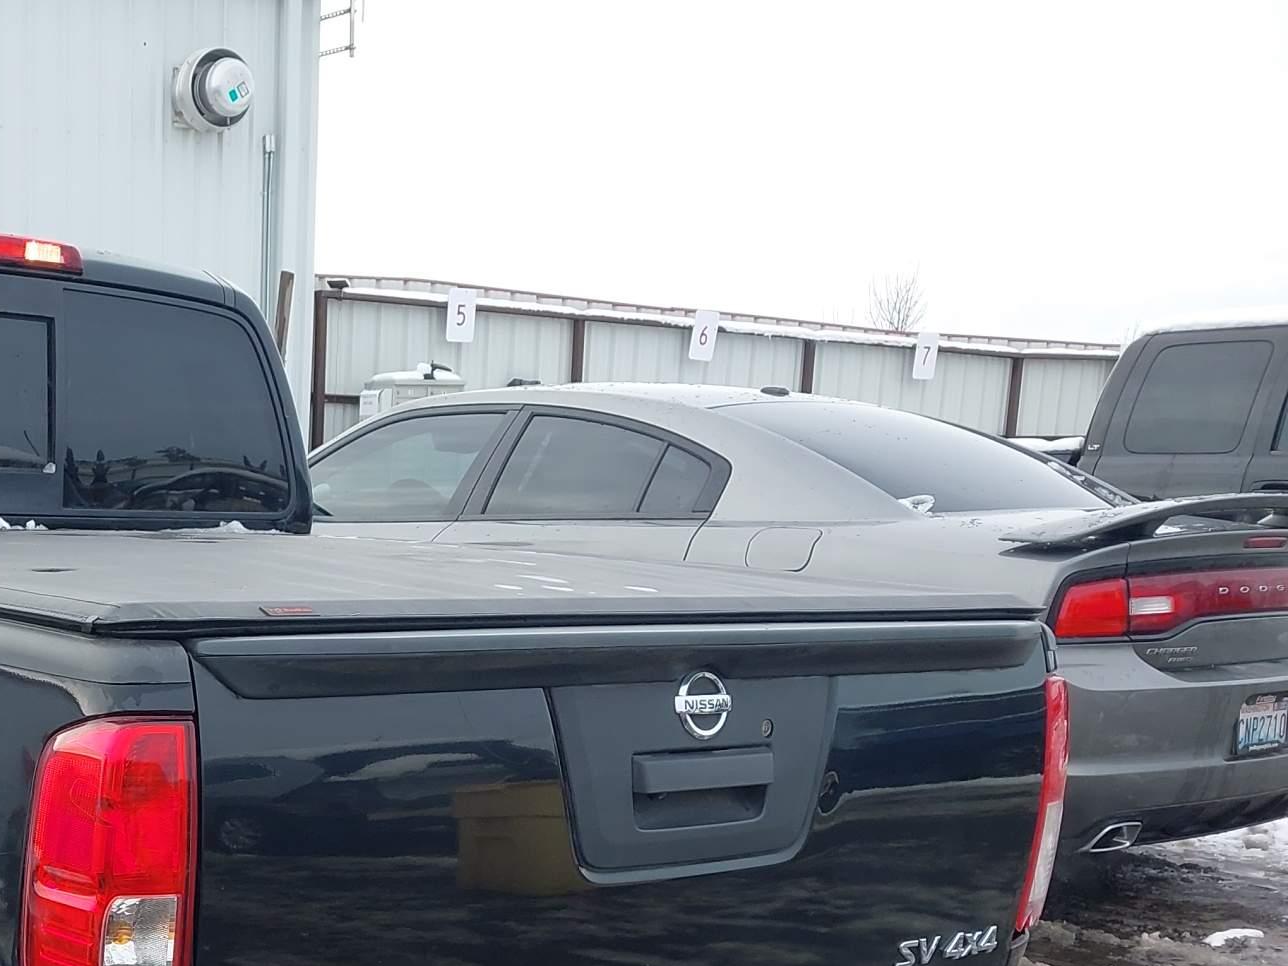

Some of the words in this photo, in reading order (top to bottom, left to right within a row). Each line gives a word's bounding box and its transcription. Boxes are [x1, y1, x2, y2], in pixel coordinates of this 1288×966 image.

[456, 304, 467, 327] 5
[699, 325, 709, 346] 6
[923, 345, 932, 366] 7
[684, 697, 730, 711] NISSAN
[1239, 712, 1287, 745] CNP2710
